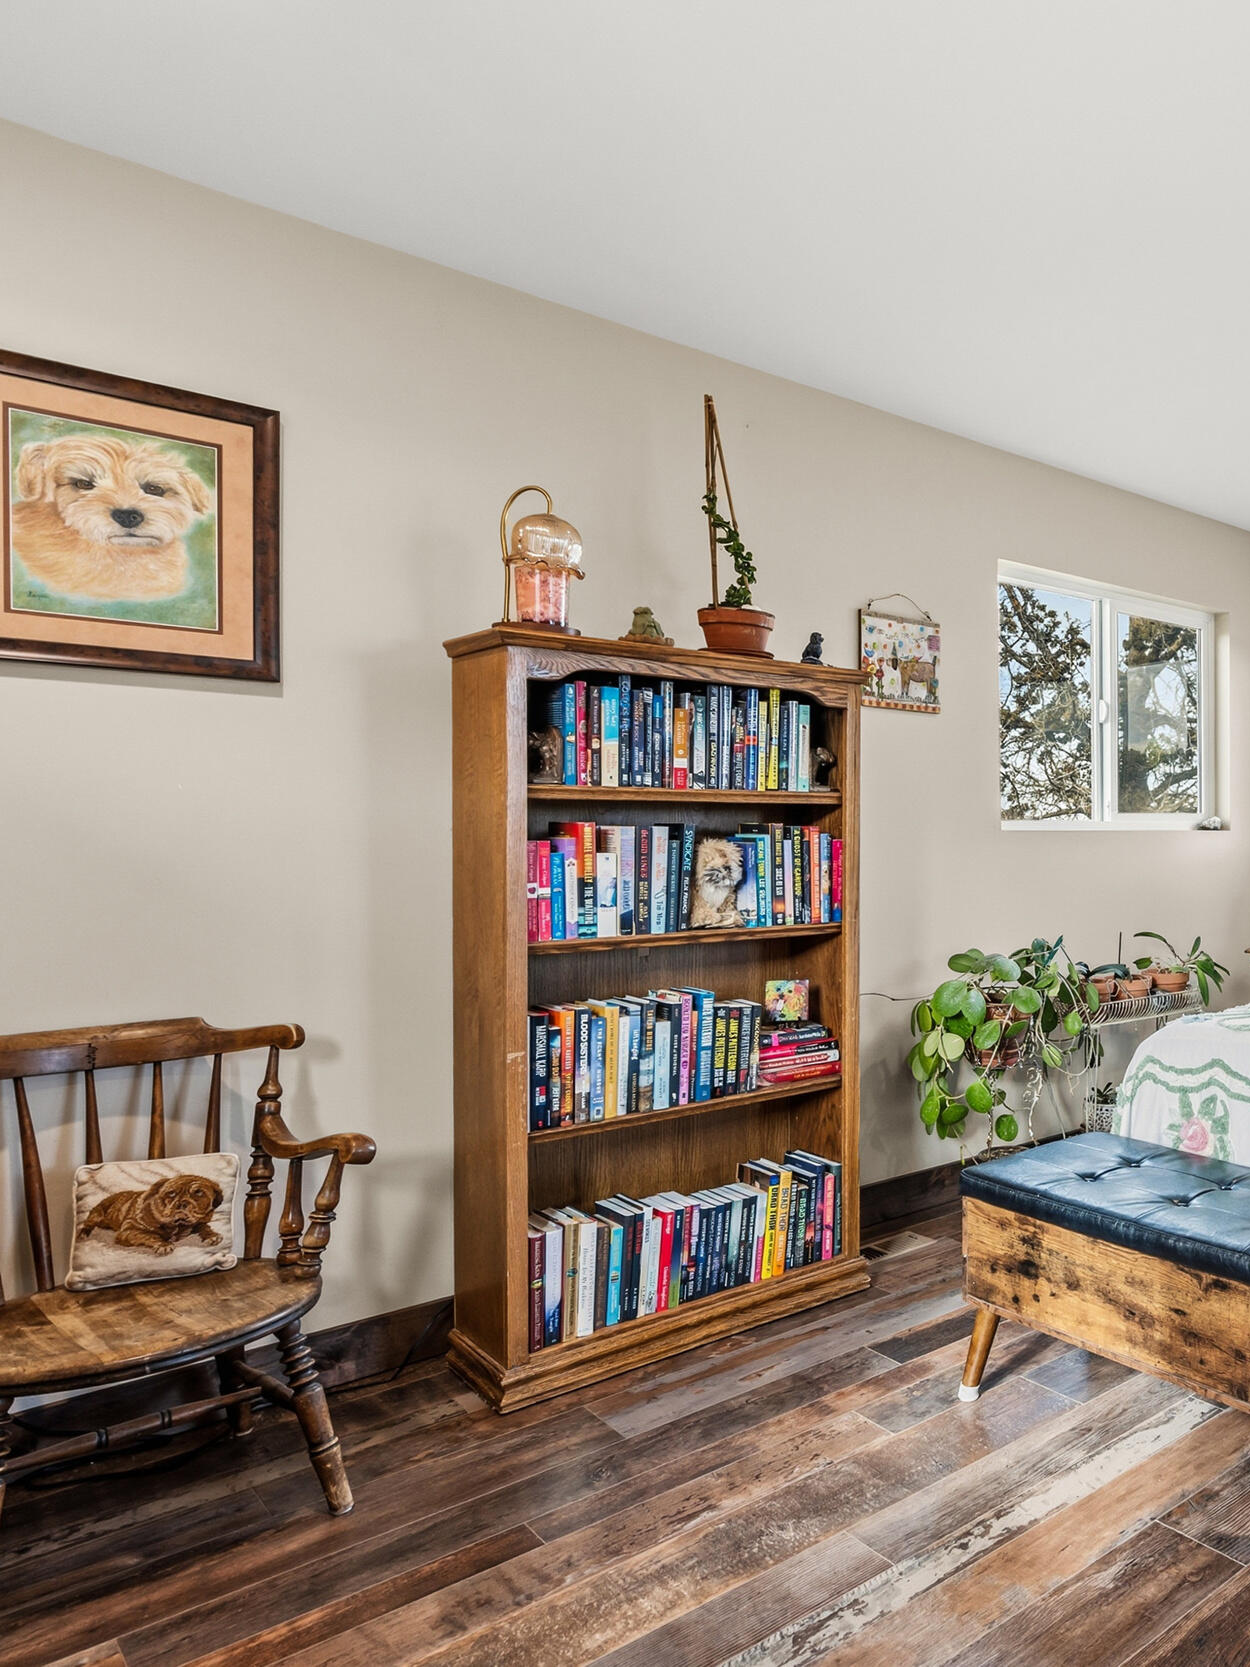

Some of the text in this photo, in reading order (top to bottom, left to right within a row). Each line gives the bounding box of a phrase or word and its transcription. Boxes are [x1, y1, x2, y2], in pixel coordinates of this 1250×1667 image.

[684, 830, 693, 871] SYNDICATE
[795, 858, 801, 866] OF
[584, 827, 593, 924] MICHAEL CONNELLY THE WAITING
[703, 998, 713, 1016] JAMES
[701, 1017, 712, 1046] PATTERSON
[716, 1018, 726, 1036] JAMES
[536, 1025, 546, 1059] MARSHALL
[714, 1037, 726, 1068] PATTERSON
[728, 1019, 738, 1070] JAMES PATTERSON
[740, 1016, 751, 1069] JAMES PATTERSON
[535, 1060, 546, 1077] KARP
[580, 1042, 588, 1075] SISTERS
[781, 1188, 789, 1209] BRAD
[769, 1210, 777, 1230] THOR
[779, 1212, 787, 1231] THOR
